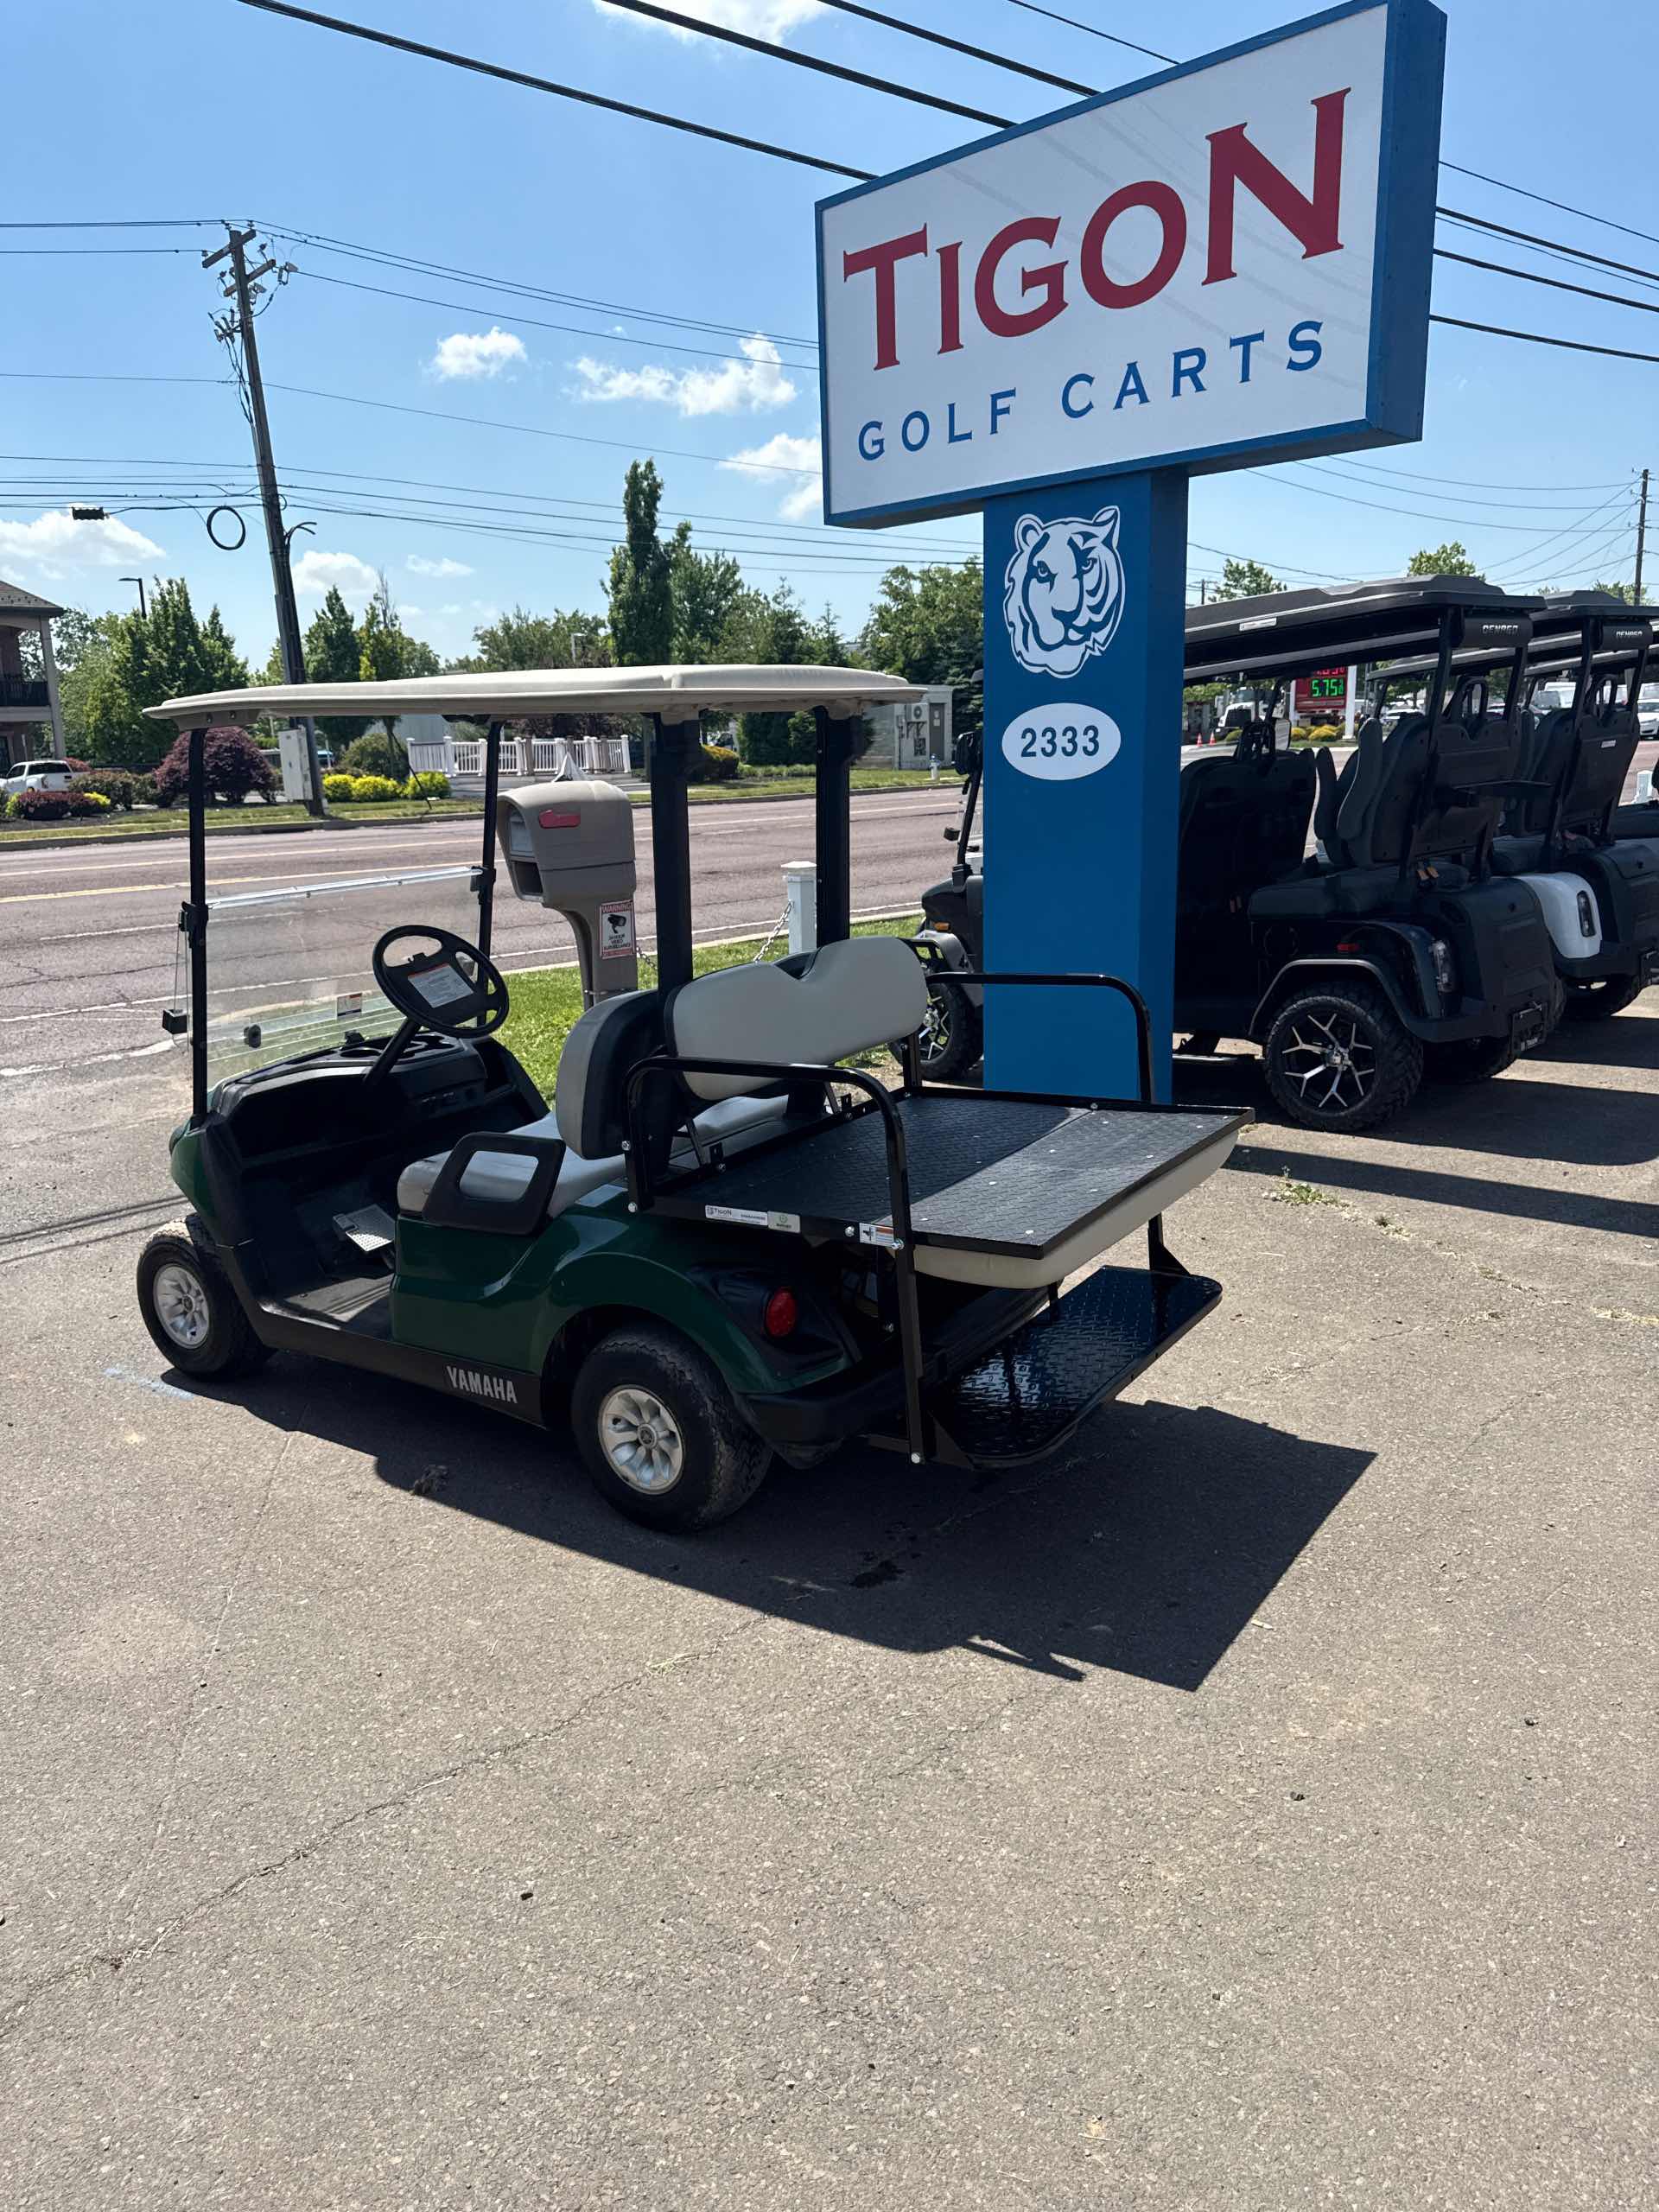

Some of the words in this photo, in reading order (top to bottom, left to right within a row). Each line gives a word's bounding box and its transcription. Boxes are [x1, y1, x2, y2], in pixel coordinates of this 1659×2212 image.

[843, 87, 1351, 371] TIGON
[858, 388, 1016, 461] GOLF
[1061, 321, 1323, 418] CARTS
[1020, 725, 1100, 758] 2333
[602, 902, 632, 912] WARNING
[446, 1365, 518, 1404] YAMAHA
